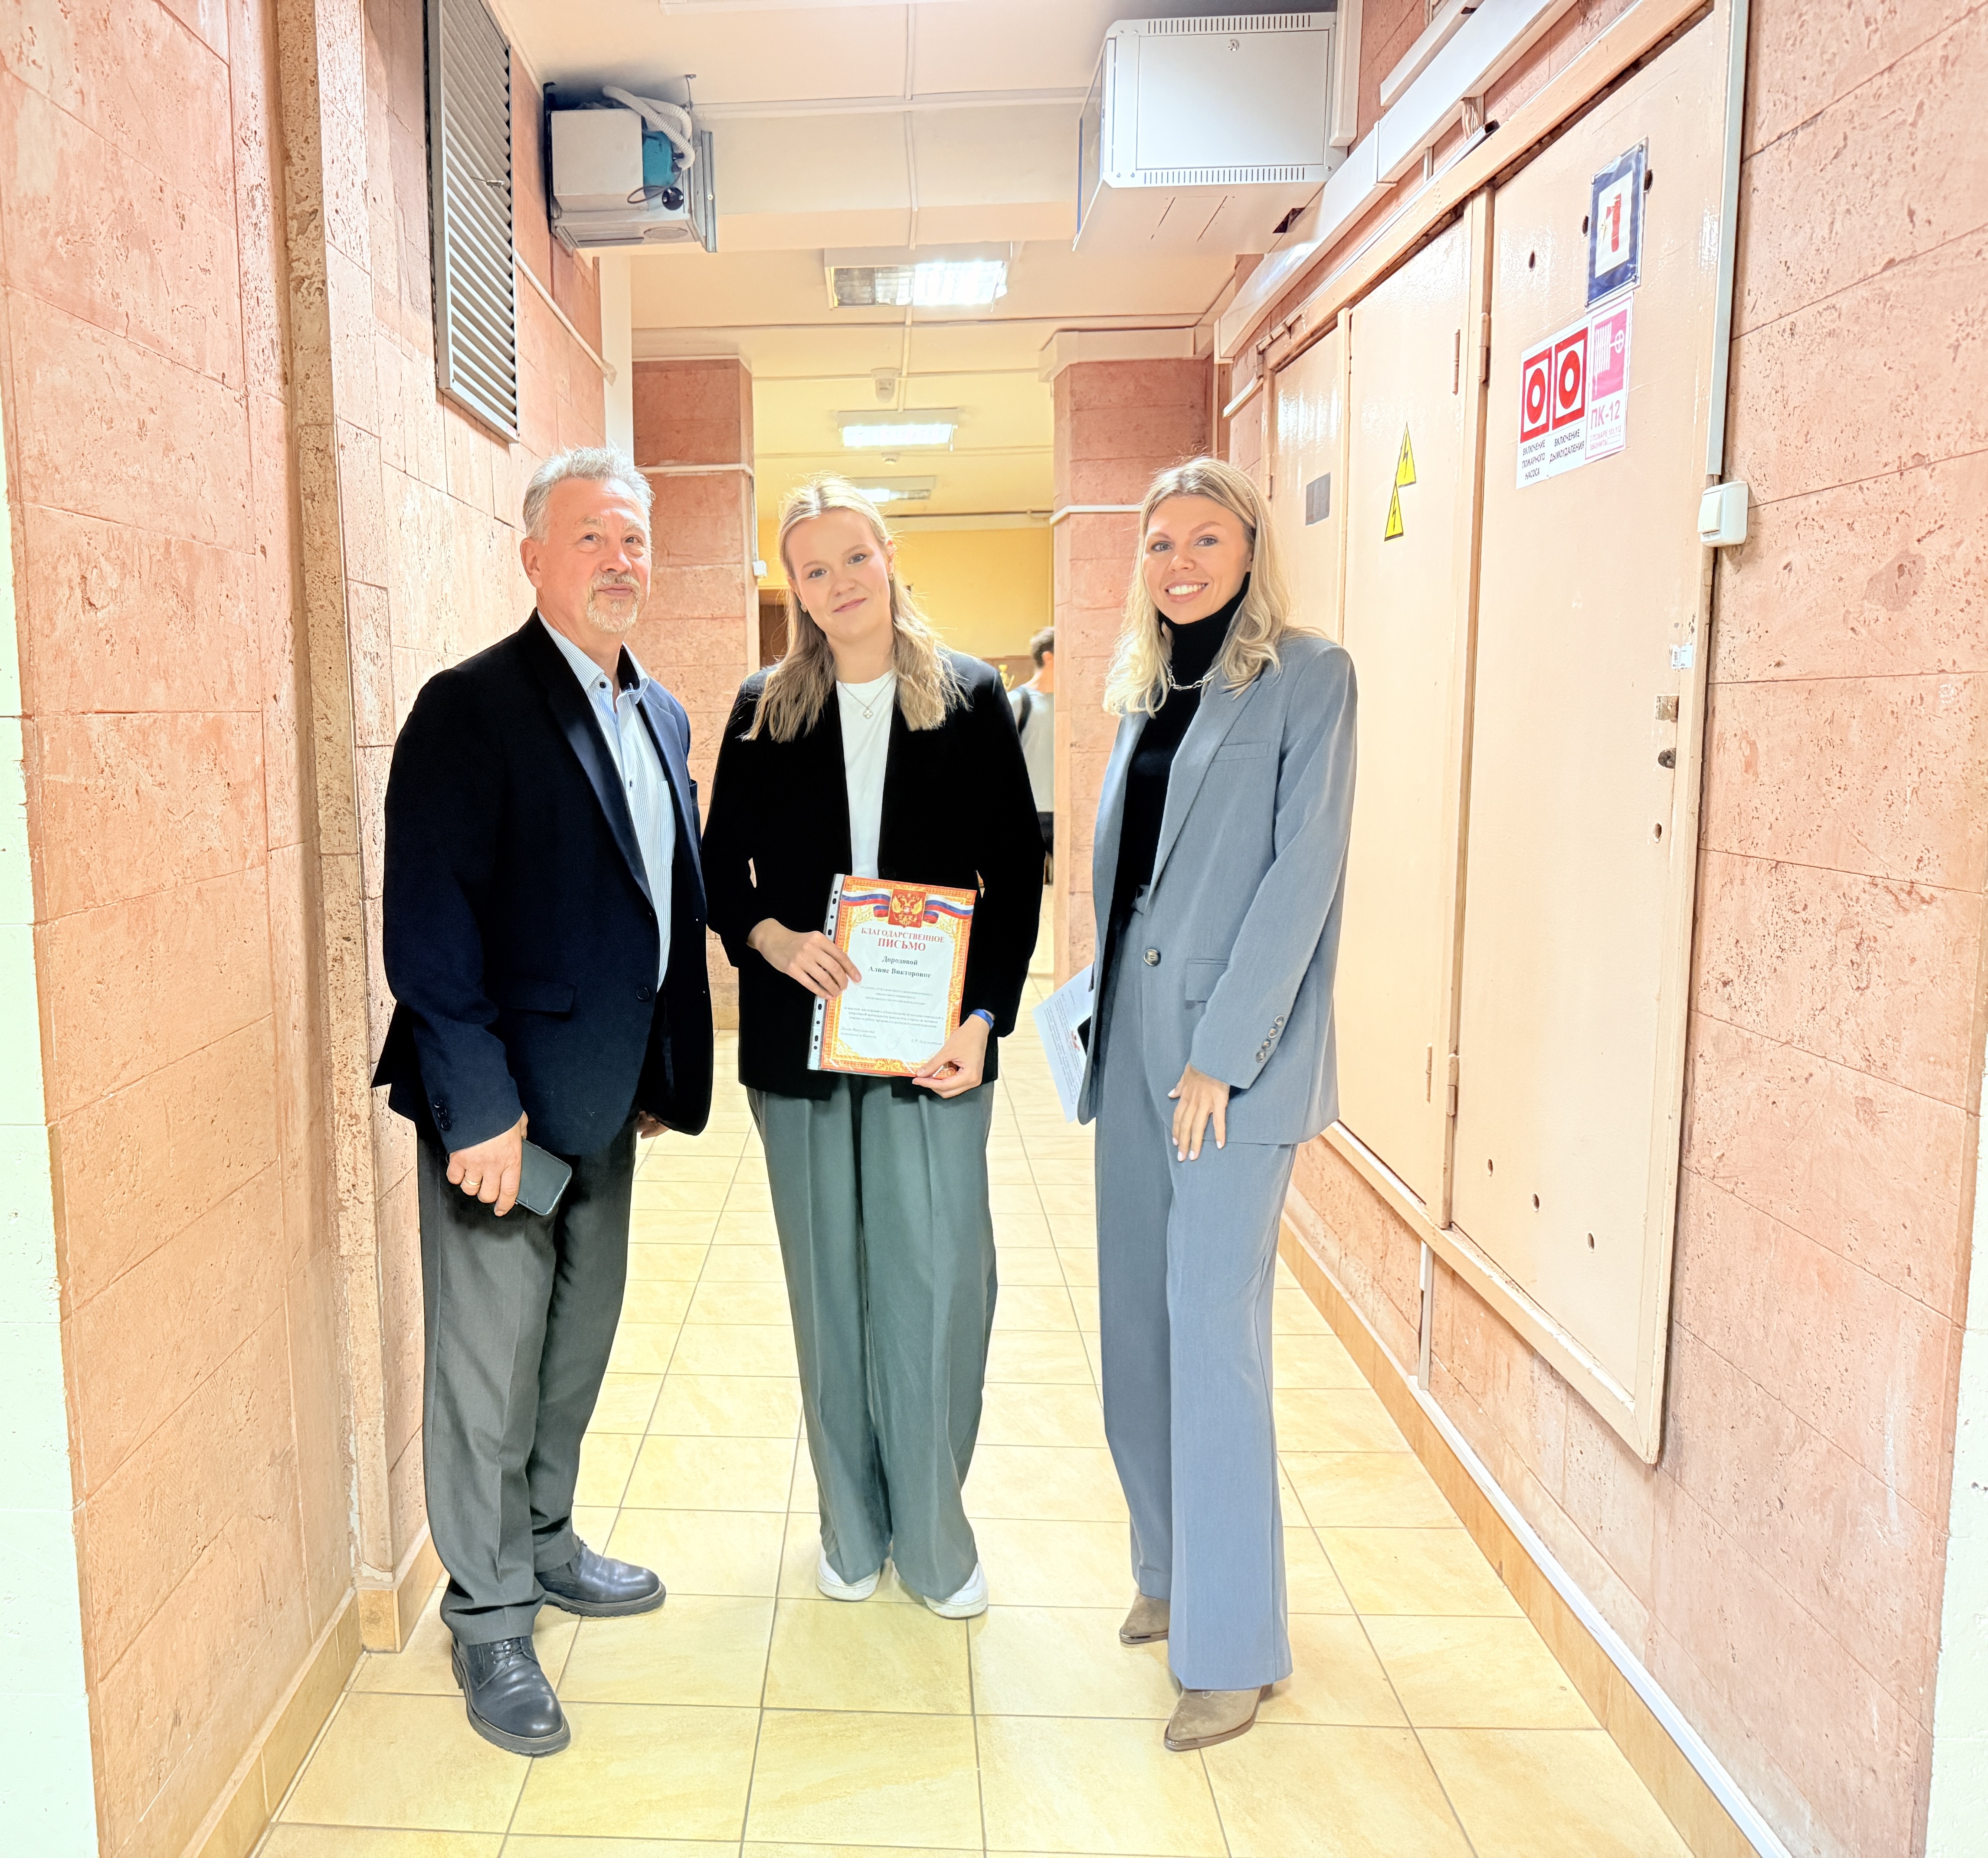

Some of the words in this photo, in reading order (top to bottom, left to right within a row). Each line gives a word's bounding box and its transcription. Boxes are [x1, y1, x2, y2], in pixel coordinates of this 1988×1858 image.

[1591, 400, 1620, 429] ПК-12
[1554, 429, 1580, 447] ВКЛЮЧЕНИЕ
[1523, 439, 1546, 456] ВКЛЮЧЕНИЕ
[1549, 441, 1585, 464] ДЫМОУДАЛЕНИЯ
[1522, 452, 1546, 469] ПОЖАРНОГО
[1525, 468, 1540, 480] НАСОСА
[861, 928, 945, 943] БЛАГОДАРСТВЕННОЕ
[878, 938, 926, 951] ПИСЬМО
[891, 968, 931, 978] Викторовне
